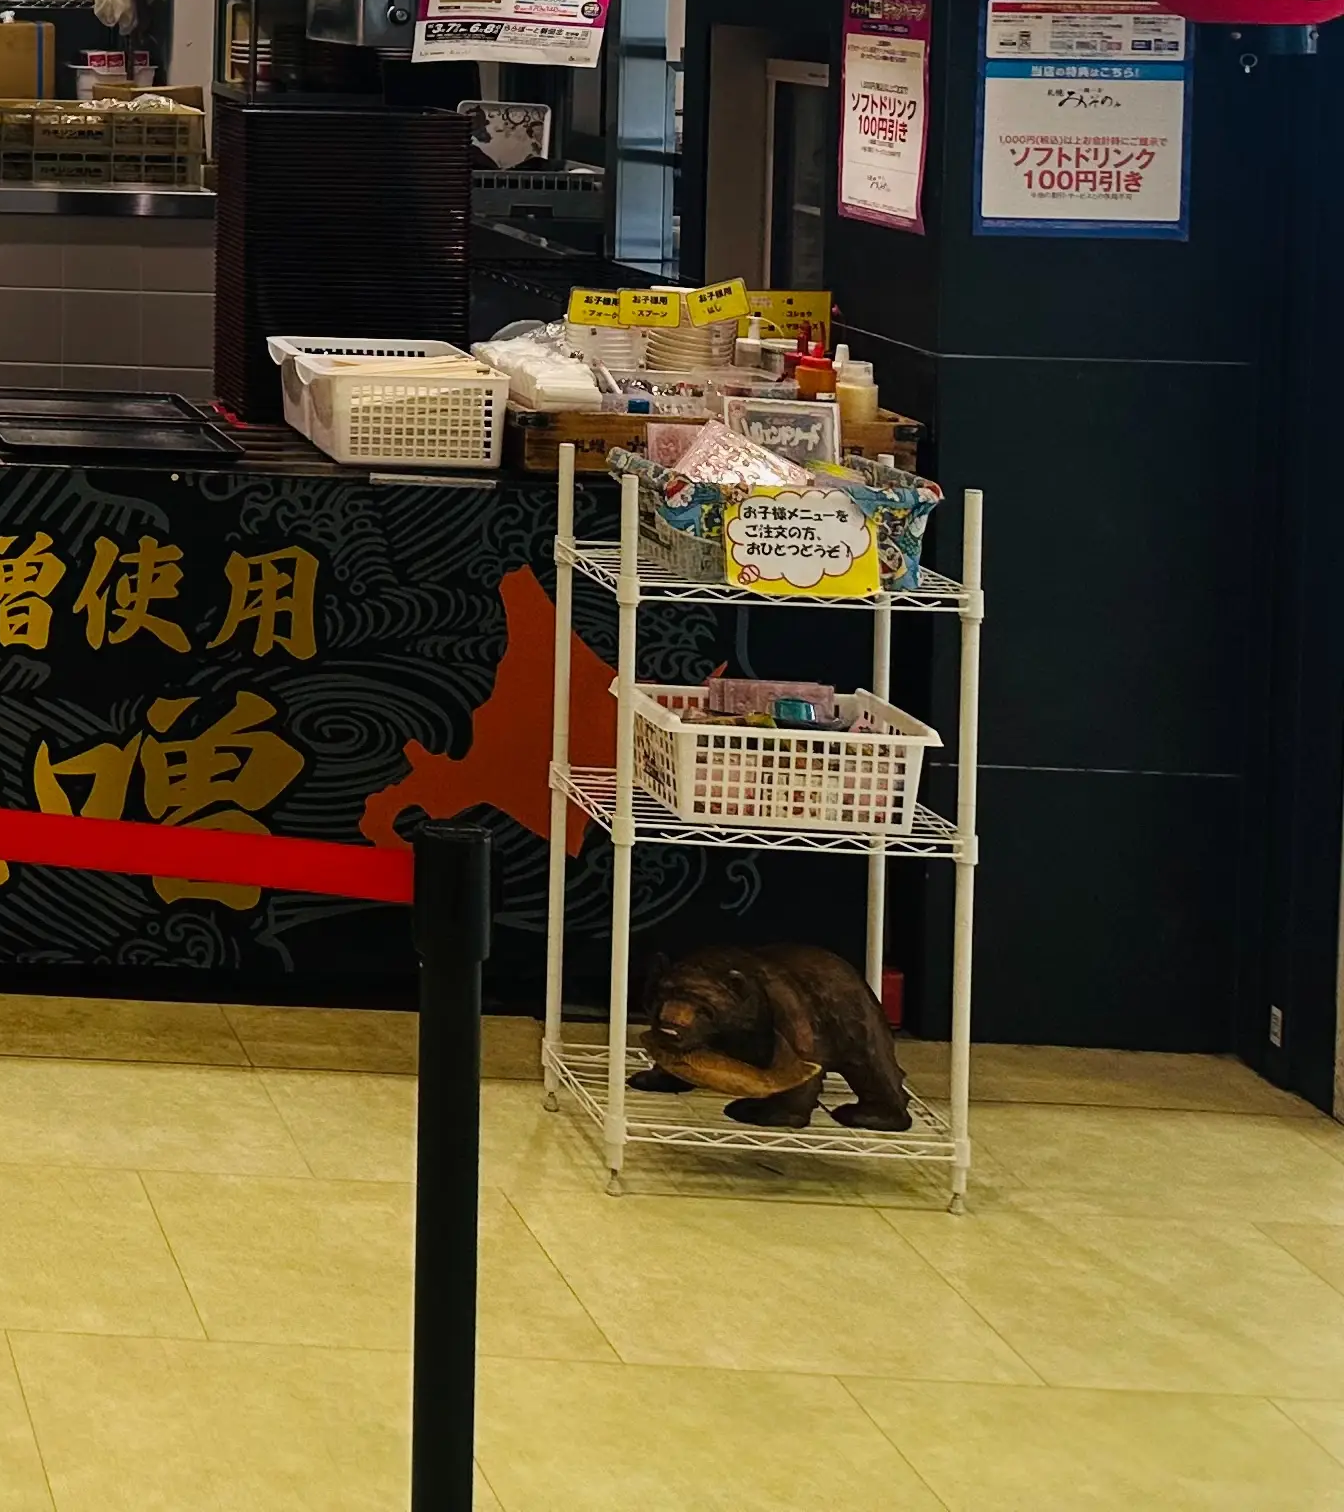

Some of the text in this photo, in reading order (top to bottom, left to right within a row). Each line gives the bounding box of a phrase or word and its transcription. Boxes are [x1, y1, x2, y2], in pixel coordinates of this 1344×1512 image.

[851, 92, 917, 121] ソフトドリンク
[858, 114, 909, 143] 100円引き
[1010, 146, 1156, 170] ソフトドリンク
[1023, 169, 1144, 193] 100円引き
[632, 295, 668, 306] お子様用
[698, 286, 733, 303] お子様用
[637, 310, 668, 318] スプーン
[743, 504, 850, 522] お子様メニューを
